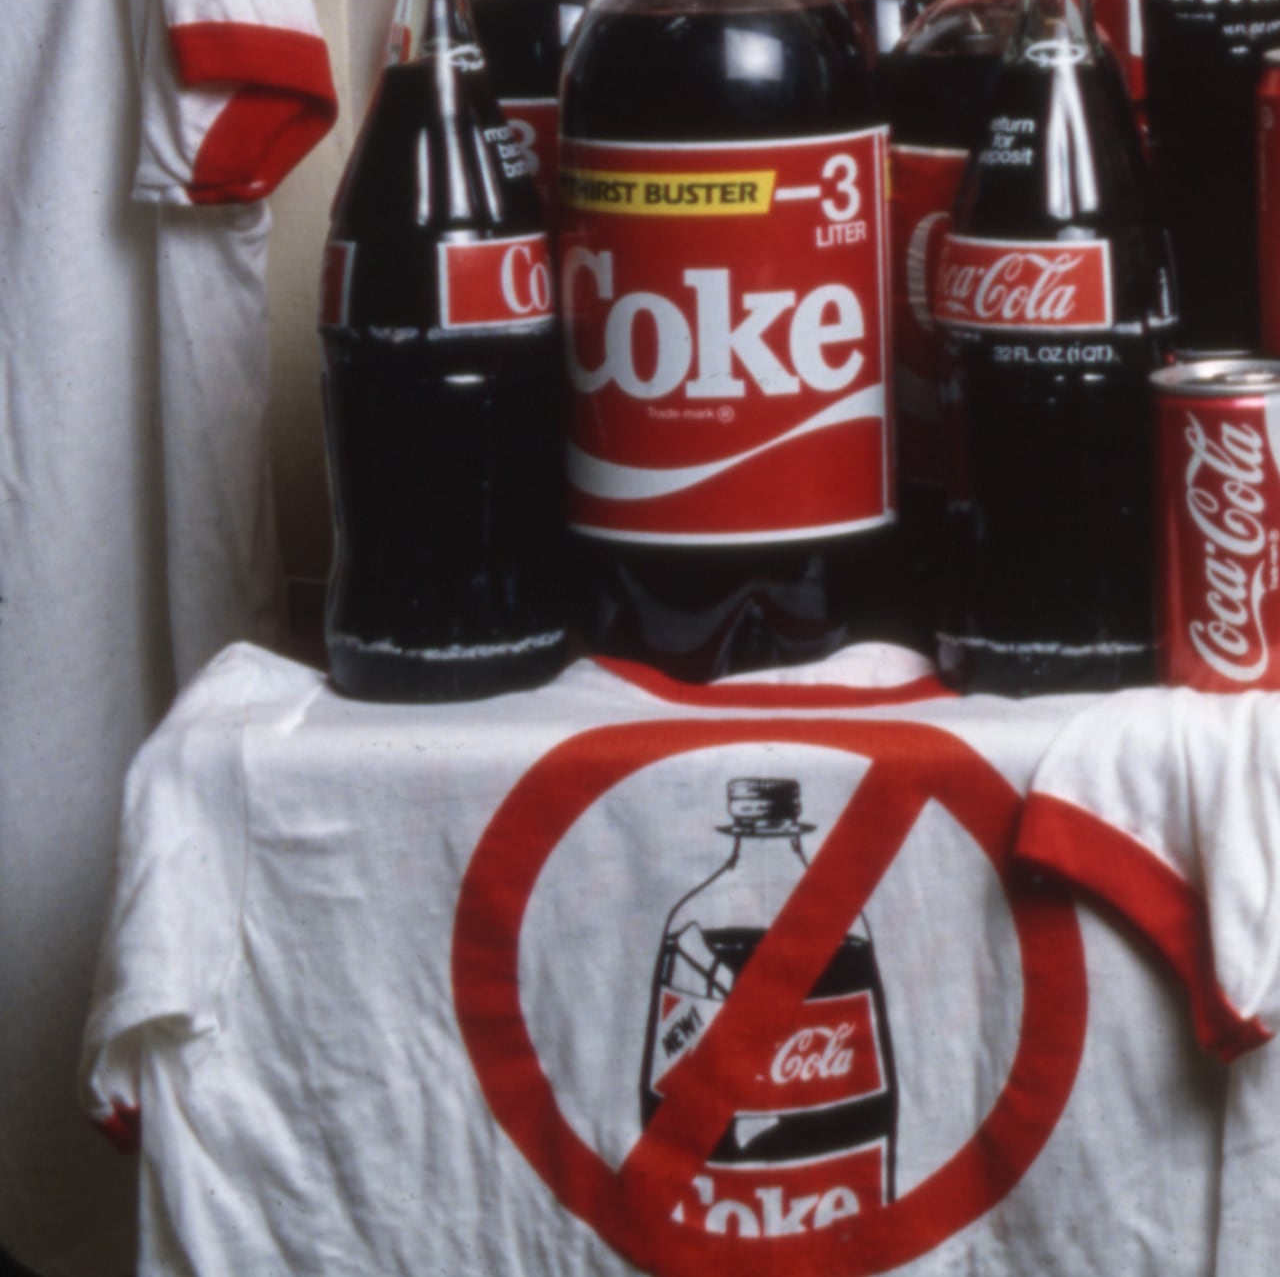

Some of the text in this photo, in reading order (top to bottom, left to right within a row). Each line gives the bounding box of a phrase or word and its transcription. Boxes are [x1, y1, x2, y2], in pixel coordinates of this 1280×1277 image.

[644, 180, 758, 205] BUSTER
[815, 220, 867, 248] LITER
[562, 245, 865, 399] Coke
[771, 1023, 856, 1084] Cola
